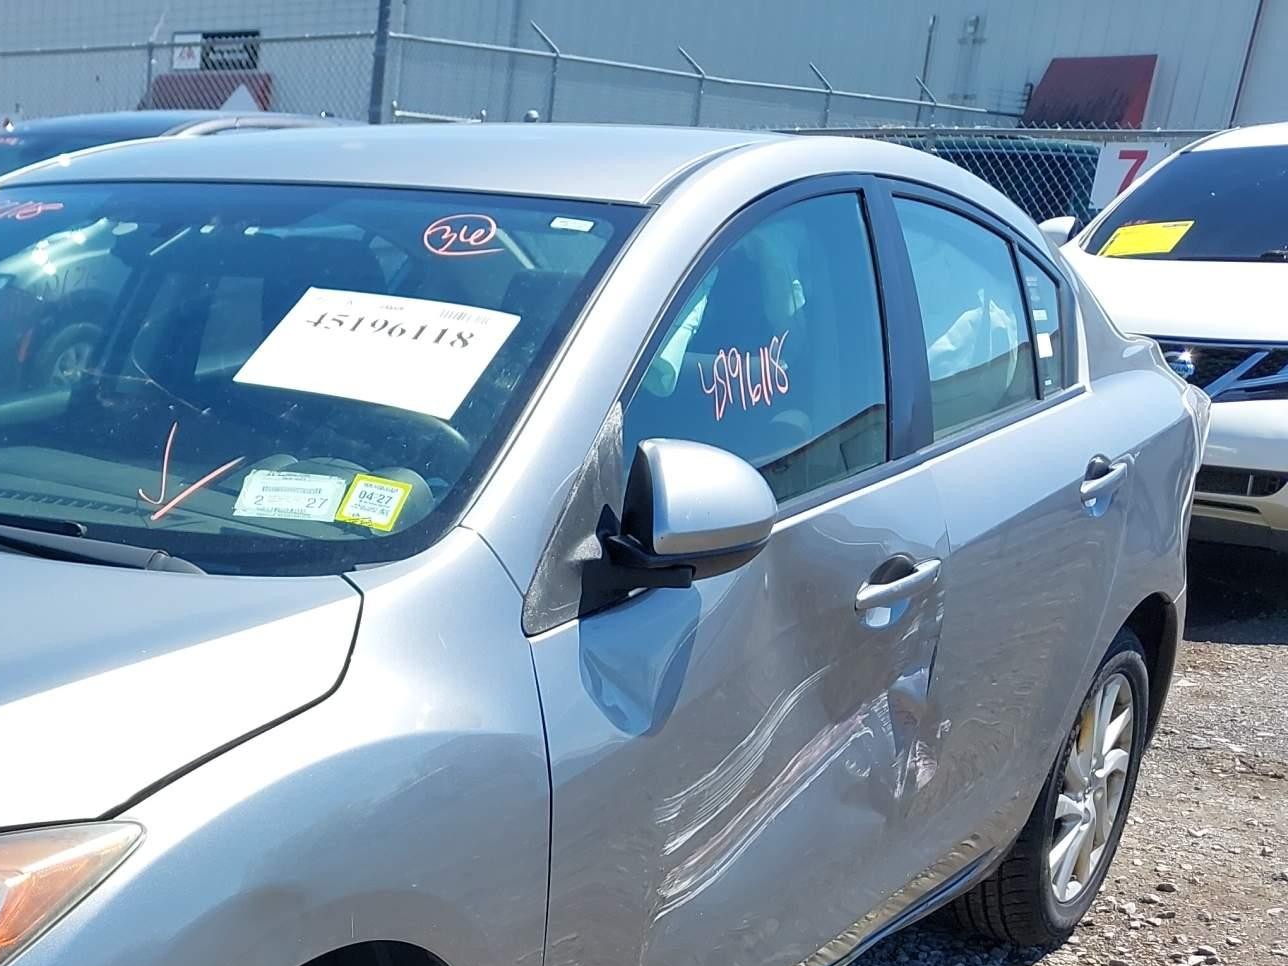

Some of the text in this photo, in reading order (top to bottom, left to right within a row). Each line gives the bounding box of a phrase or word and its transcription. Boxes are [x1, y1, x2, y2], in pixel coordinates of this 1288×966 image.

[1117, 149, 1149, 196] 7
[306, 312, 475, 349] 45196118
[253, 494, 329, 509] 2 27
